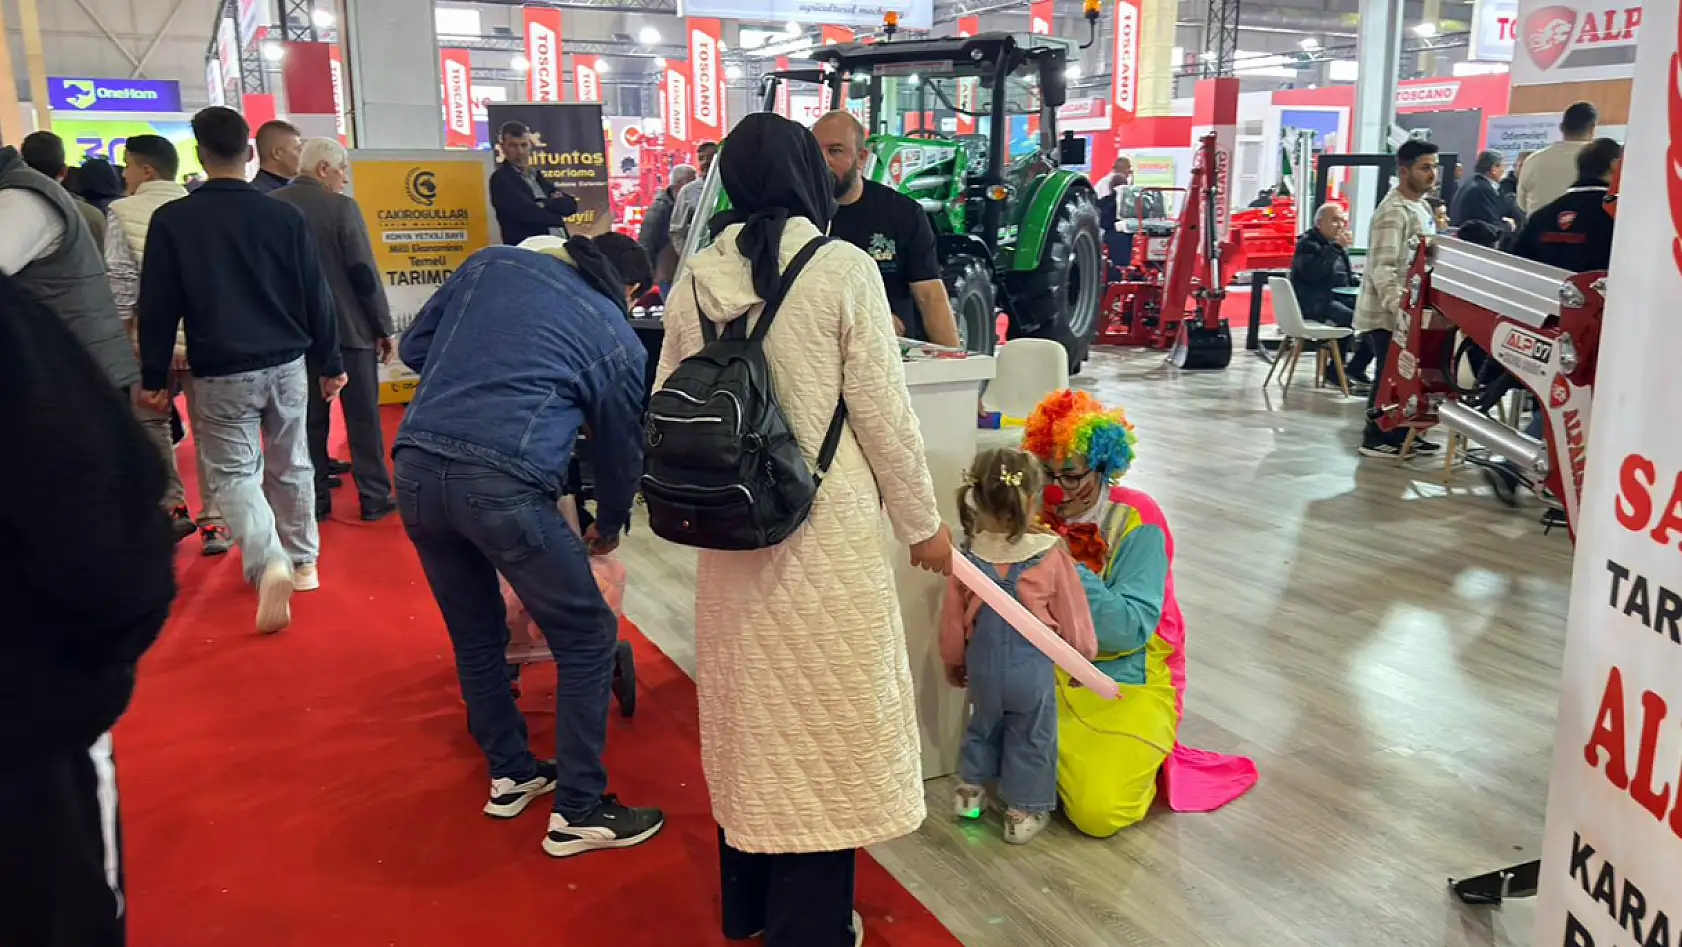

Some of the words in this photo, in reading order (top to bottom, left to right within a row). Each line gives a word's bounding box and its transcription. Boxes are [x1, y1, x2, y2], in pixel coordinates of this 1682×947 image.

[1119, 12, 1132, 102] TOSCANO
[1576, 7, 1643, 44] ALP
[451, 68, 464, 128] TOSCANO
[698, 42, 711, 117] TOSCANO
[1506, 333, 1533, 350] ALP
[1534, 341, 1552, 361] 07
[1584, 666, 1682, 840] AL
